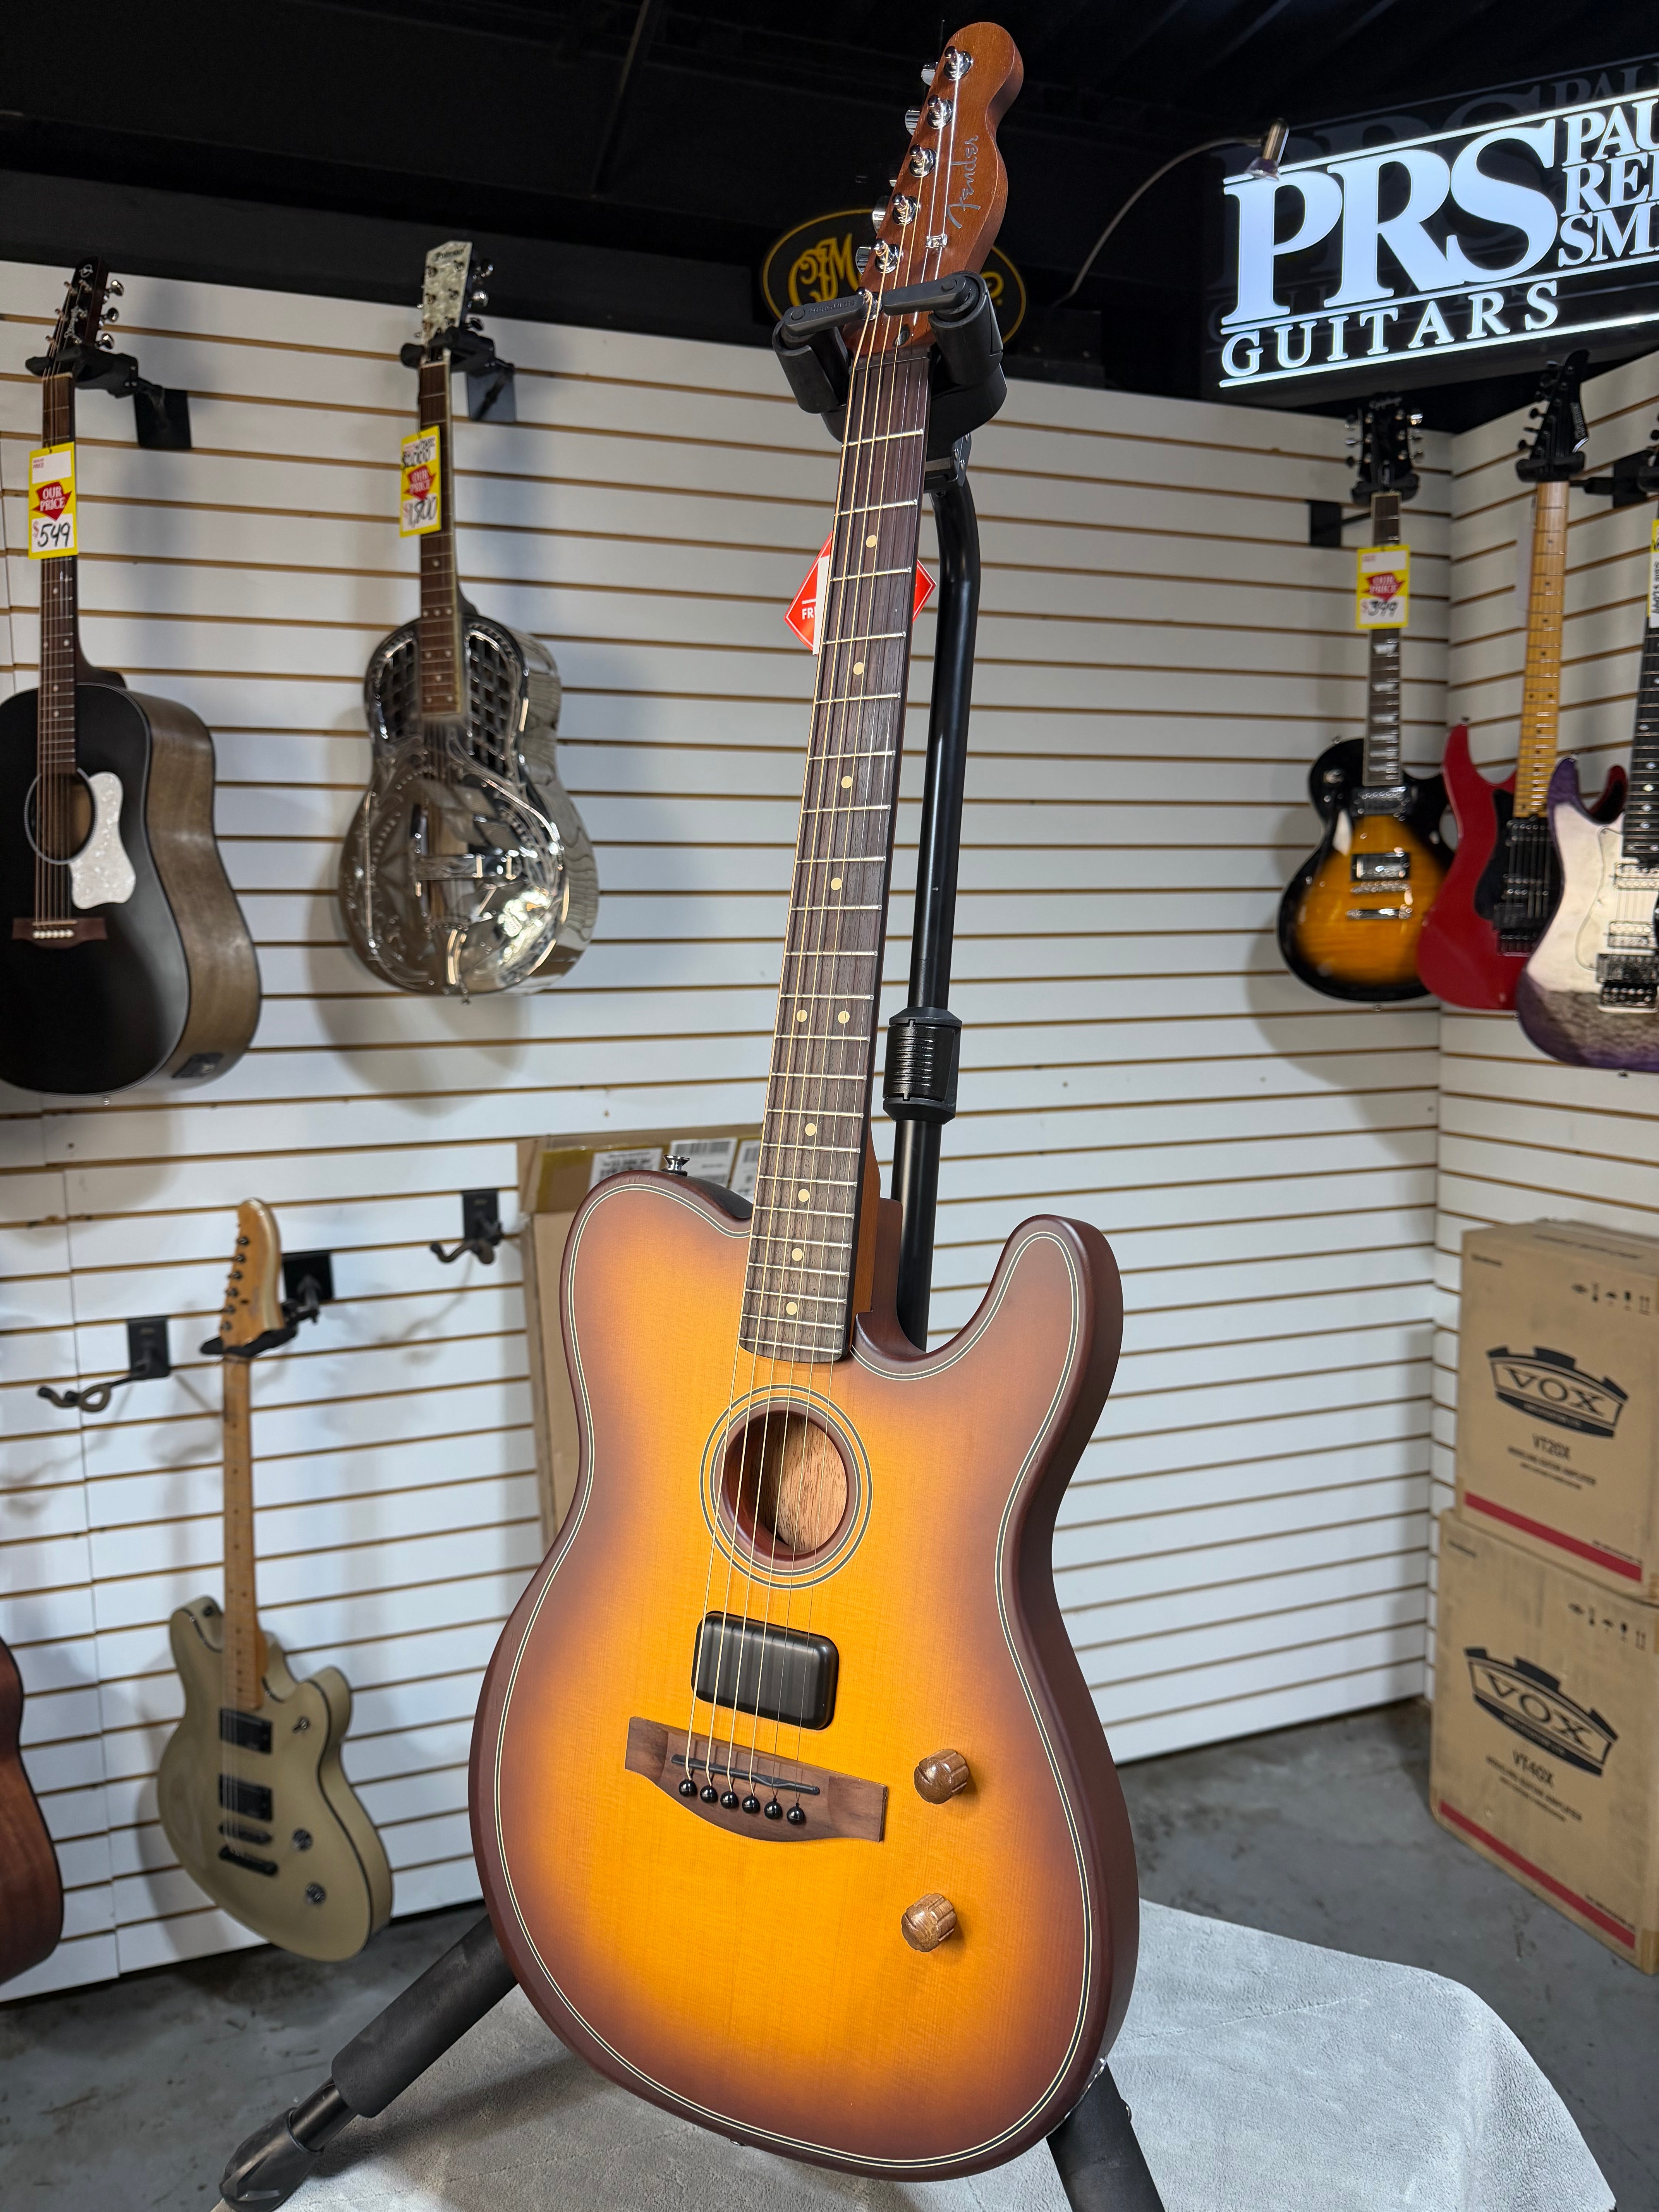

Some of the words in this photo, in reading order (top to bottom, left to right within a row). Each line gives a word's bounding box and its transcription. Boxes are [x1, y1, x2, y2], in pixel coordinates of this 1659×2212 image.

[947, 135, 981, 229] Fender
[1560, 151, 1659, 218] RE
[1222, 119, 1558, 325] PRS
[1558, 201, 1659, 268] SM
[809, 300, 855, 314] HERCULES
[1221, 280, 1559, 378] GUITARS
[40, 496, 65, 512] PRICE
[42, 486, 62, 498] OUR
[33, 521, 71, 548] $549
[802, 606, 816, 620] FR
[1503, 1368, 1606, 1417] VOX
[1481, 1669, 1592, 1749] VOX
